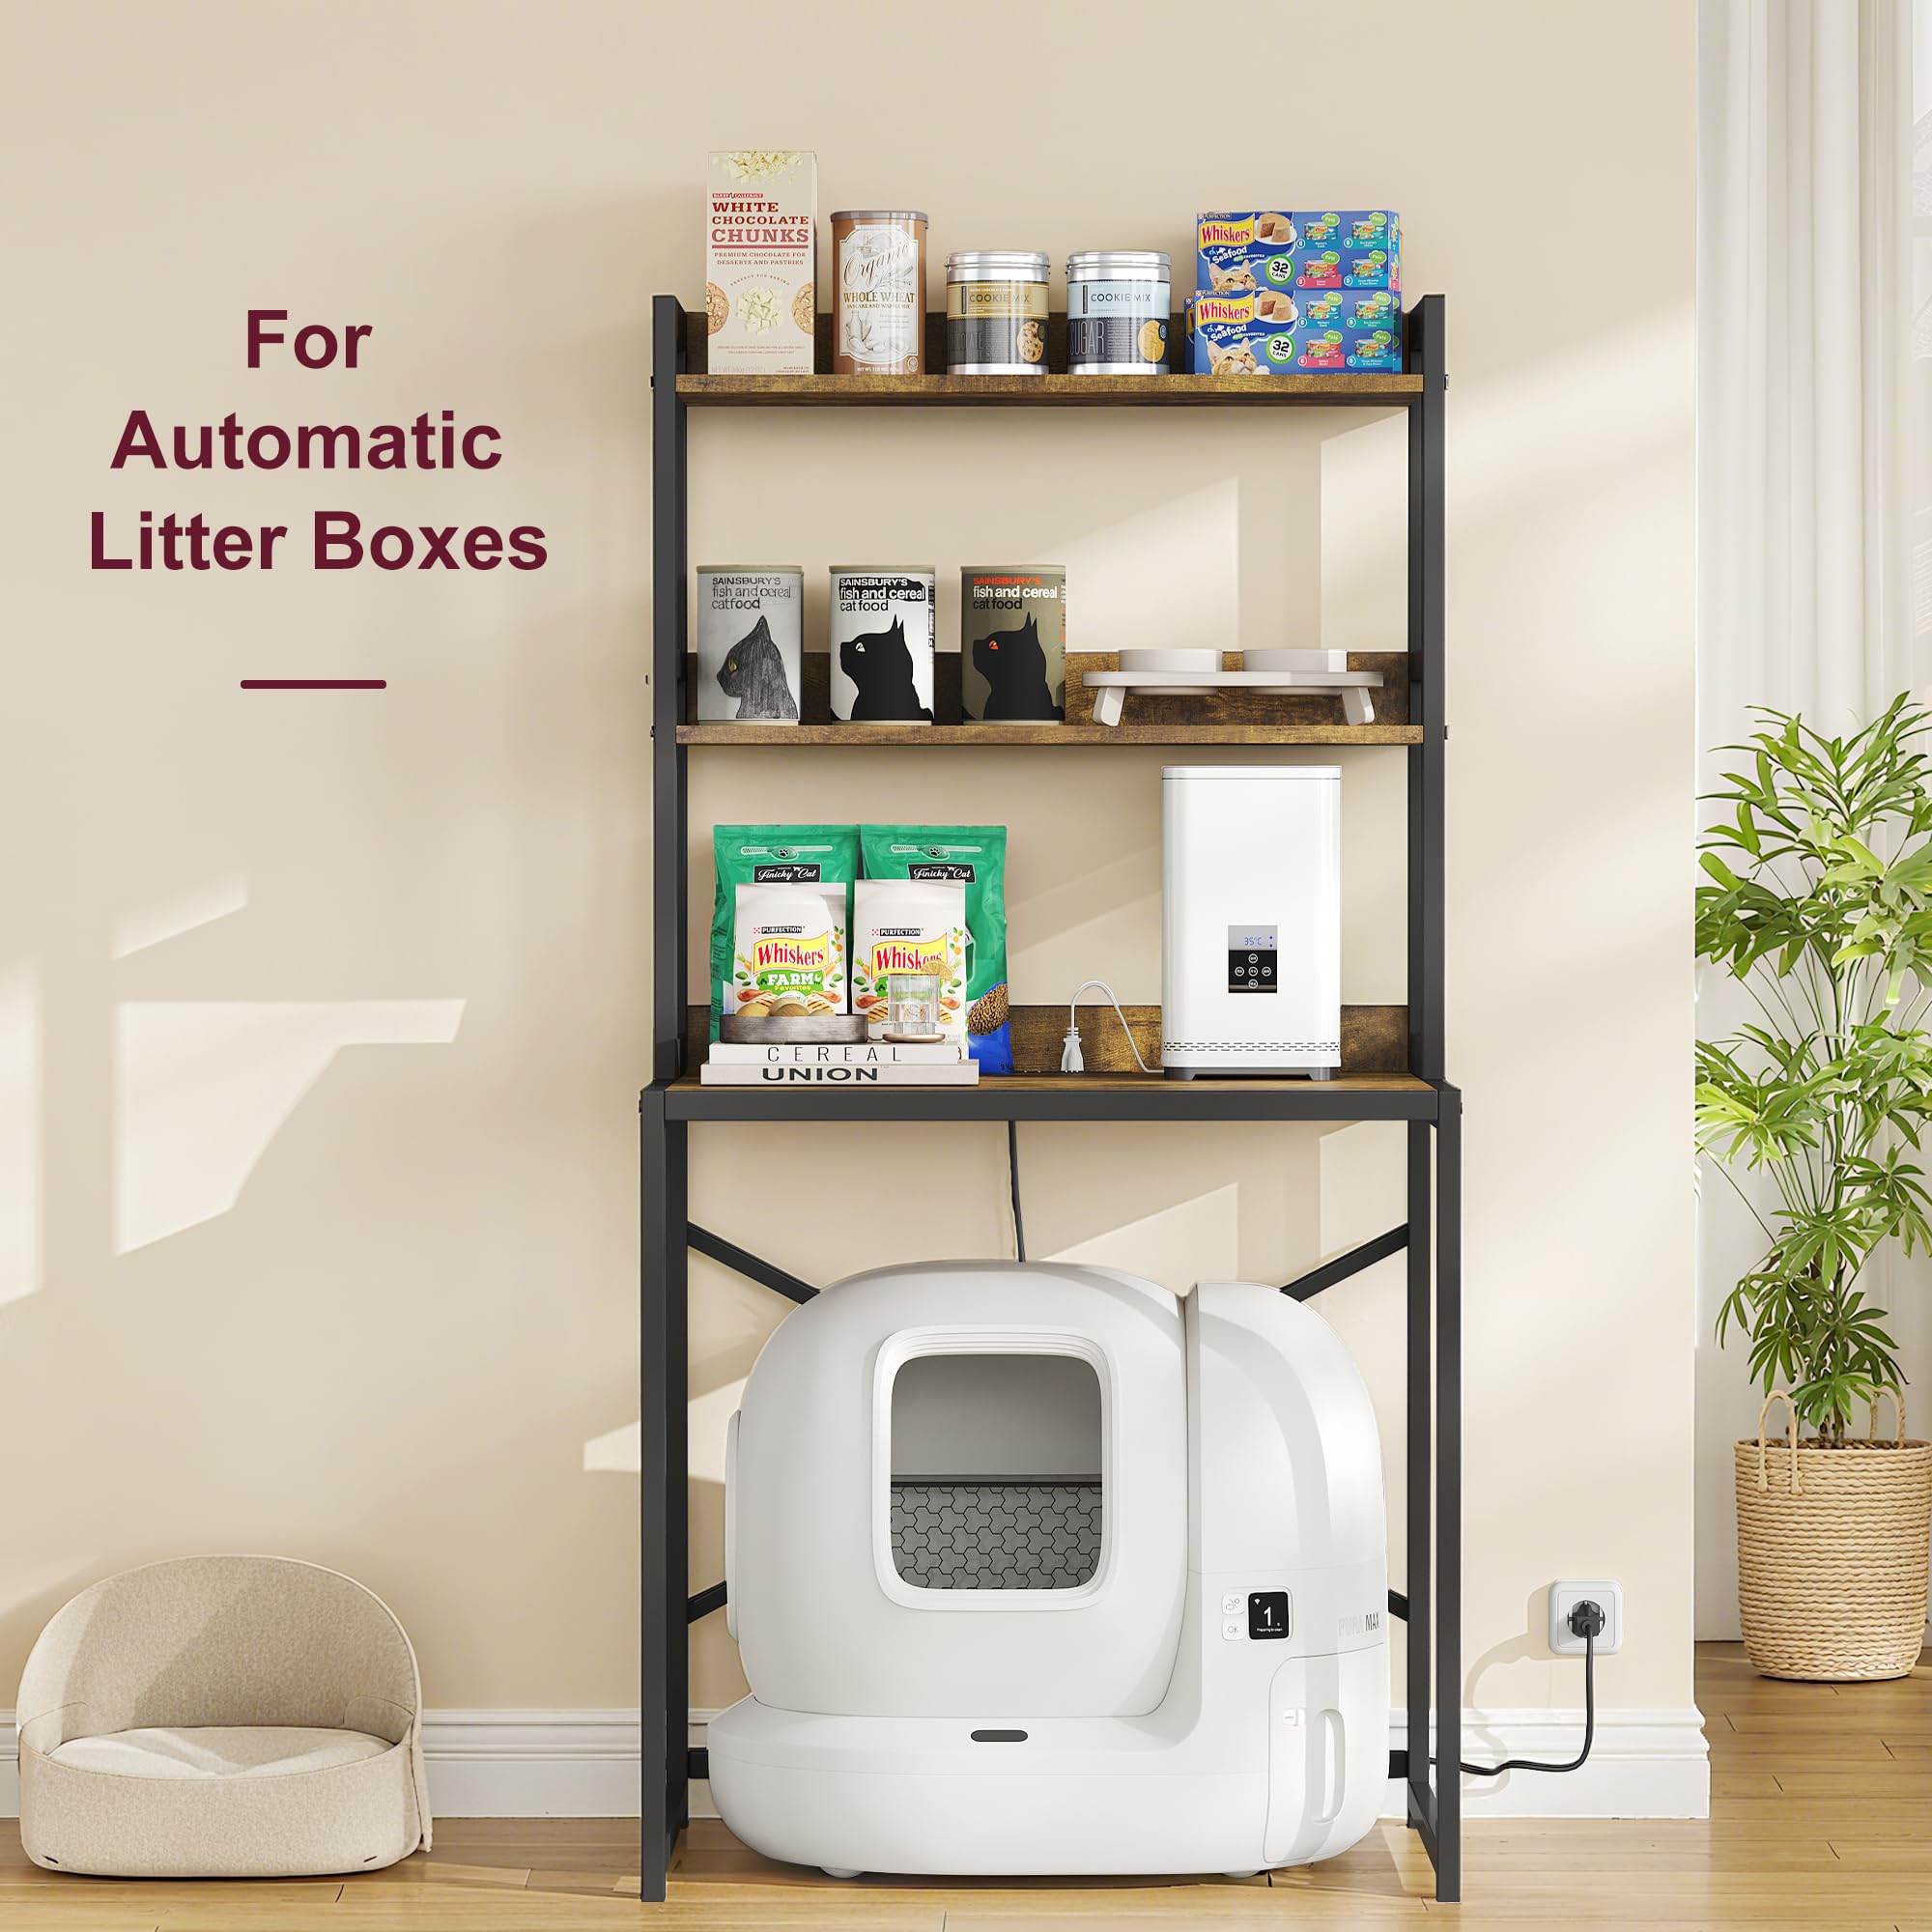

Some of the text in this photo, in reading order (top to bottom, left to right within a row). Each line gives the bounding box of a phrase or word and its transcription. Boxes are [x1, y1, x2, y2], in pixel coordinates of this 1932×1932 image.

[712, 202, 779, 213] WHITE
[712, 215, 809, 225] CHOCOLATE
[711, 228, 809, 242] CHUNKS
[1202, 224, 1251, 244] Whiskers
[1212, 245, 1248, 264] Seafood
[844, 242, 909, 293] Organic
[1272, 261, 1289, 274] 32
[843, 292, 916, 303] WHOLE WHEAT
[969, 294, 1009, 302] COOKIE
[1091, 293, 1151, 302] COOKIE MIX
[1200, 301, 1250, 321] Whiskers
[1069, 321, 1105, 355] SUGAR
[1210, 325, 1247, 342] Seafood
[1272, 340, 1290, 353] 32
[712, 577, 781, 585] SAINSBURY'S
[839, 578, 908, 586] SAINSBURY'S
[973, 577, 1042, 585] SAINSBURY'S
[712, 585, 791, 598] fish and cereal
[839, 586, 924, 600] fish and cereal
[973, 585, 1058, 599] fish and cereal
[839, 599, 889, 611] cat food
[973, 598, 1023, 610] cat food
[757, 867, 817, 881] Finicky Cat
[914, 867, 971, 880] Finicky Cat
[757, 942, 824, 966] Whiskers
[767, 973, 814, 986] FARM
[767, 1046, 902, 1063] CEREAL
[762, 1067, 878, 1081] UNION
[1365, 1612, 1380, 1631] MAX
